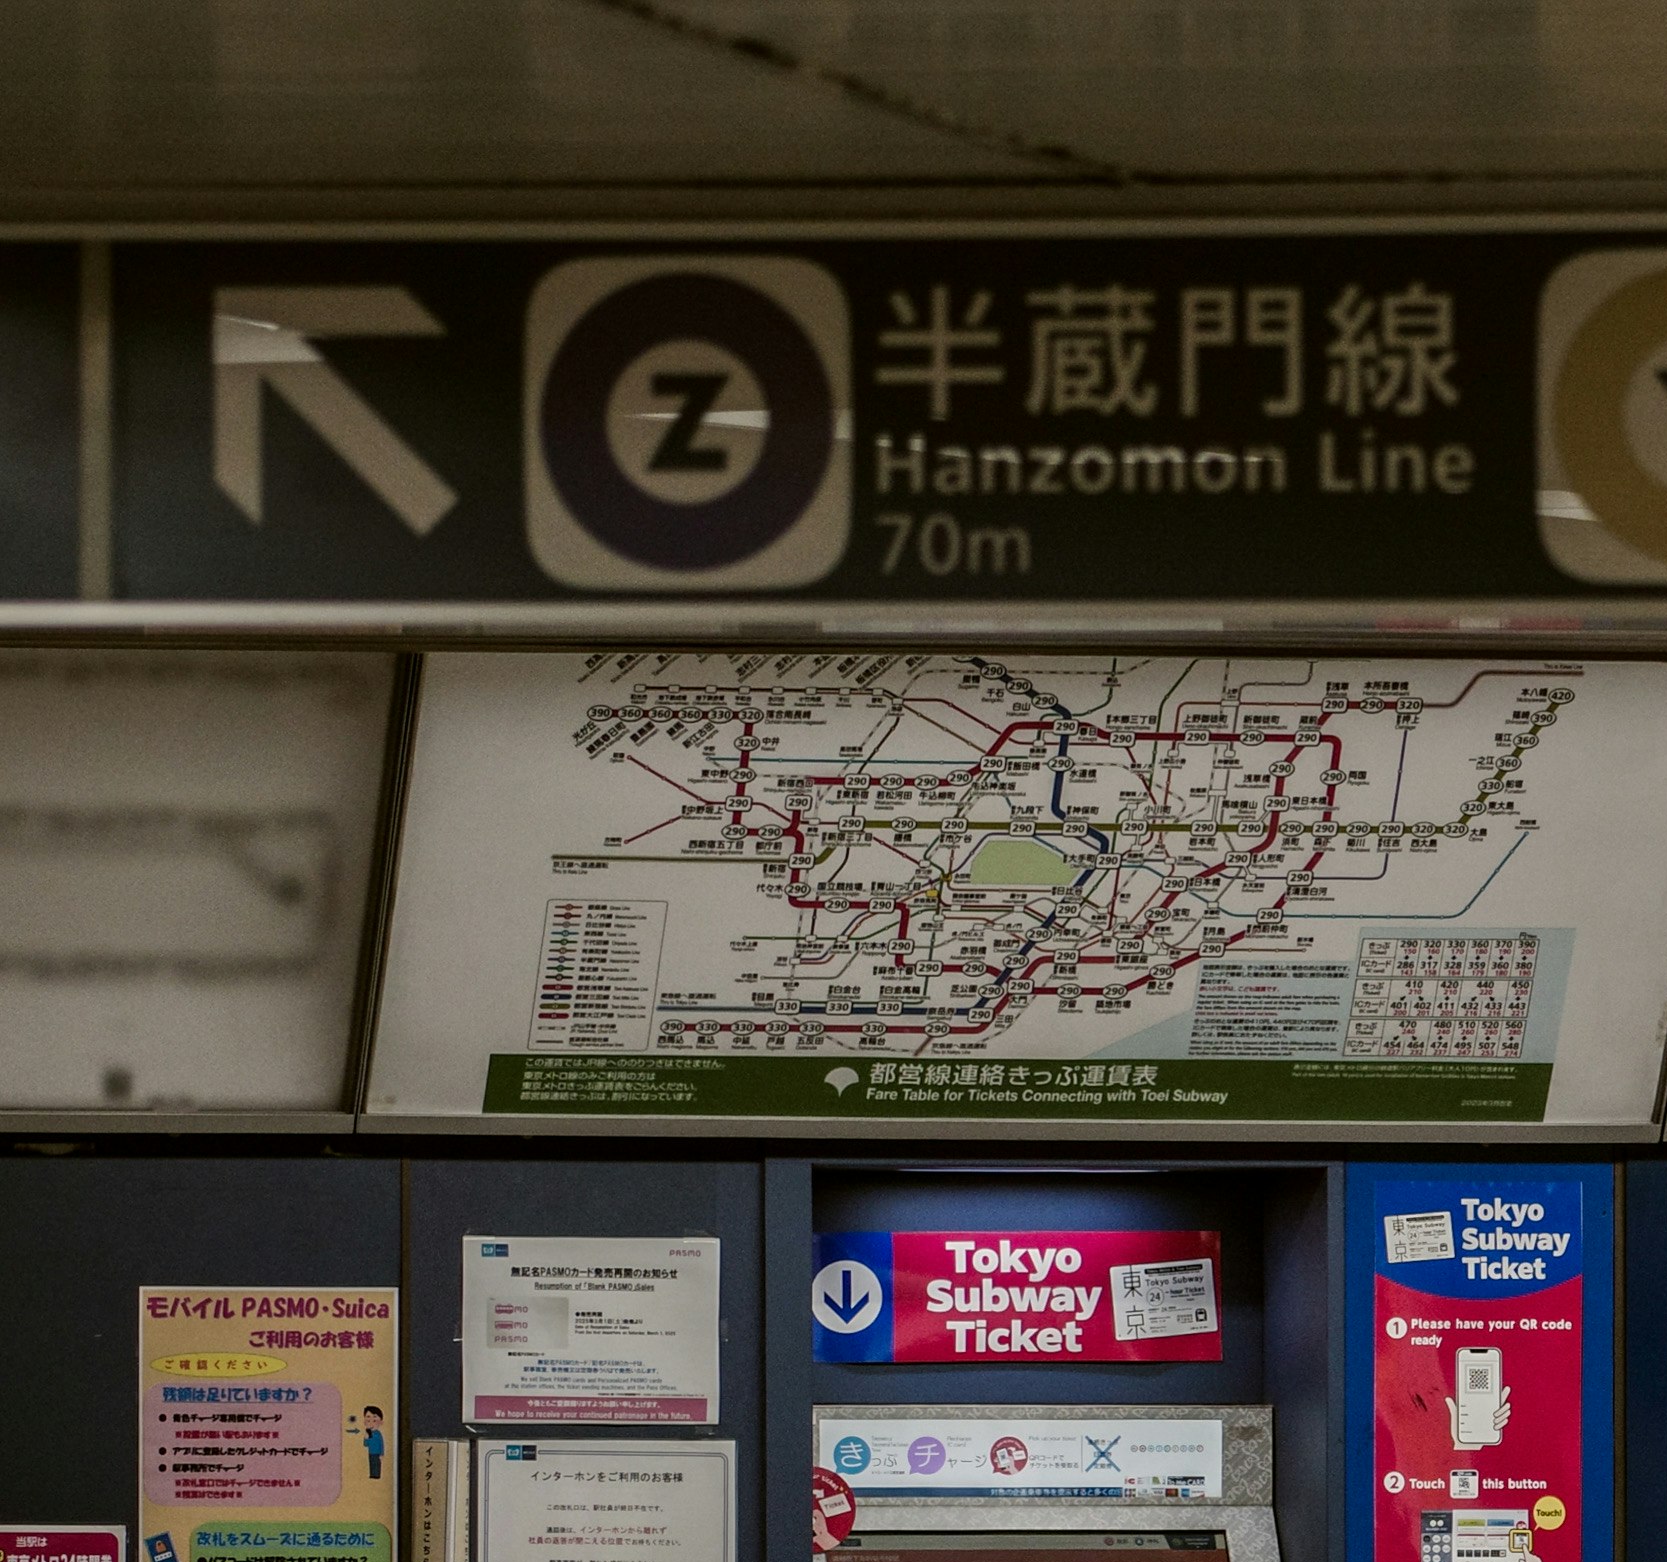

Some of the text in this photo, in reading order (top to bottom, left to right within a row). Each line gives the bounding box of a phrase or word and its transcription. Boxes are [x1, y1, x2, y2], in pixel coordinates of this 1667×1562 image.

[873, 286, 1460, 417] 半蔵門線
[873, 432, 1476, 496] Hanzomon Line
[873, 514, 1032, 575] 70m
[869, 1062, 1159, 1087] 都営線連絡きっぷ運賃表
[866, 1087, 1228, 1105] Fare Table for Tickets Connecting with Toei Subway
[1460, 1196, 1545, 1228] Tokyo
[1461, 1226, 1571, 1258] Subway
[669, 1250, 701, 1258] PASMO
[944, 1239, 1083, 1282] Tokyo
[511, 1266, 678, 1278] 無記名PASMOカード発売再開のお知らせ
[1461, 1256, 1547, 1280] Ticket
[146, 1297, 390, 1319] モバイル PASMO・Suica
[924, 1278, 1104, 1321] Subway
[1410, 1318, 1452, 1330] Please
[1455, 1318, 1484, 1330] have
[1488, 1319, 1516, 1332] your
[1519, 1318, 1538, 1331] QR
[1541, 1318, 1572, 1331] code
[248, 1330, 374, 1348] ご利用のお客様
[945, 1319, 1084, 1354] Ticket
[1410, 1335, 1443, 1348] ready
[164, 1360, 268, 1370] ご確認ください
[162, 1387, 312, 1402] 残額は足りていますか？
[531, 1471, 683, 1483] インターホンをご利用のお客様
[1408, 1478, 1446, 1490] Touch
[1482, 1478, 1505, 1490] this
[1507, 1478, 1548, 1490] button
[1536, 1508, 1562, 1518] Touch!
[16, 1536, 48, 1548] 当駅は
[196, 1532, 374, 1547] 改札をスムーズに通るために
